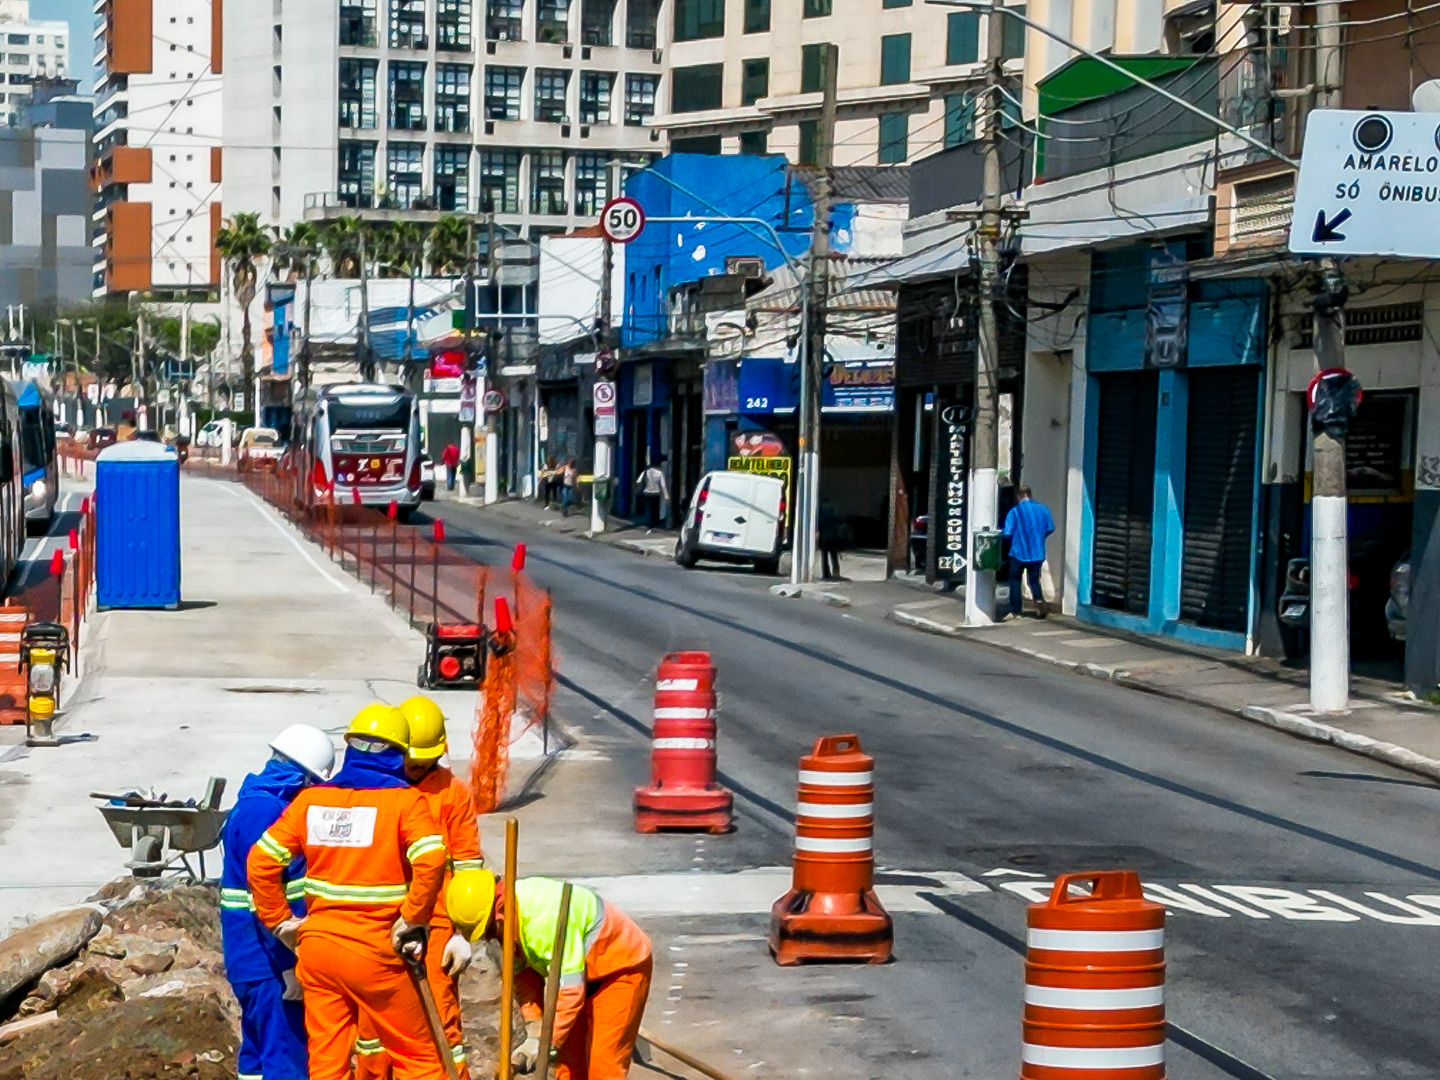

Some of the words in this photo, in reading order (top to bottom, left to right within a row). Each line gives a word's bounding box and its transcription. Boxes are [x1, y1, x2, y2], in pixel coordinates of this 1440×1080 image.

[1343, 153, 1439, 173] AMARELO
[1335, 178, 1361, 200] SÓ
[1378, 181, 1440, 203] ÔNIBU
[609, 208, 637, 229] 50
